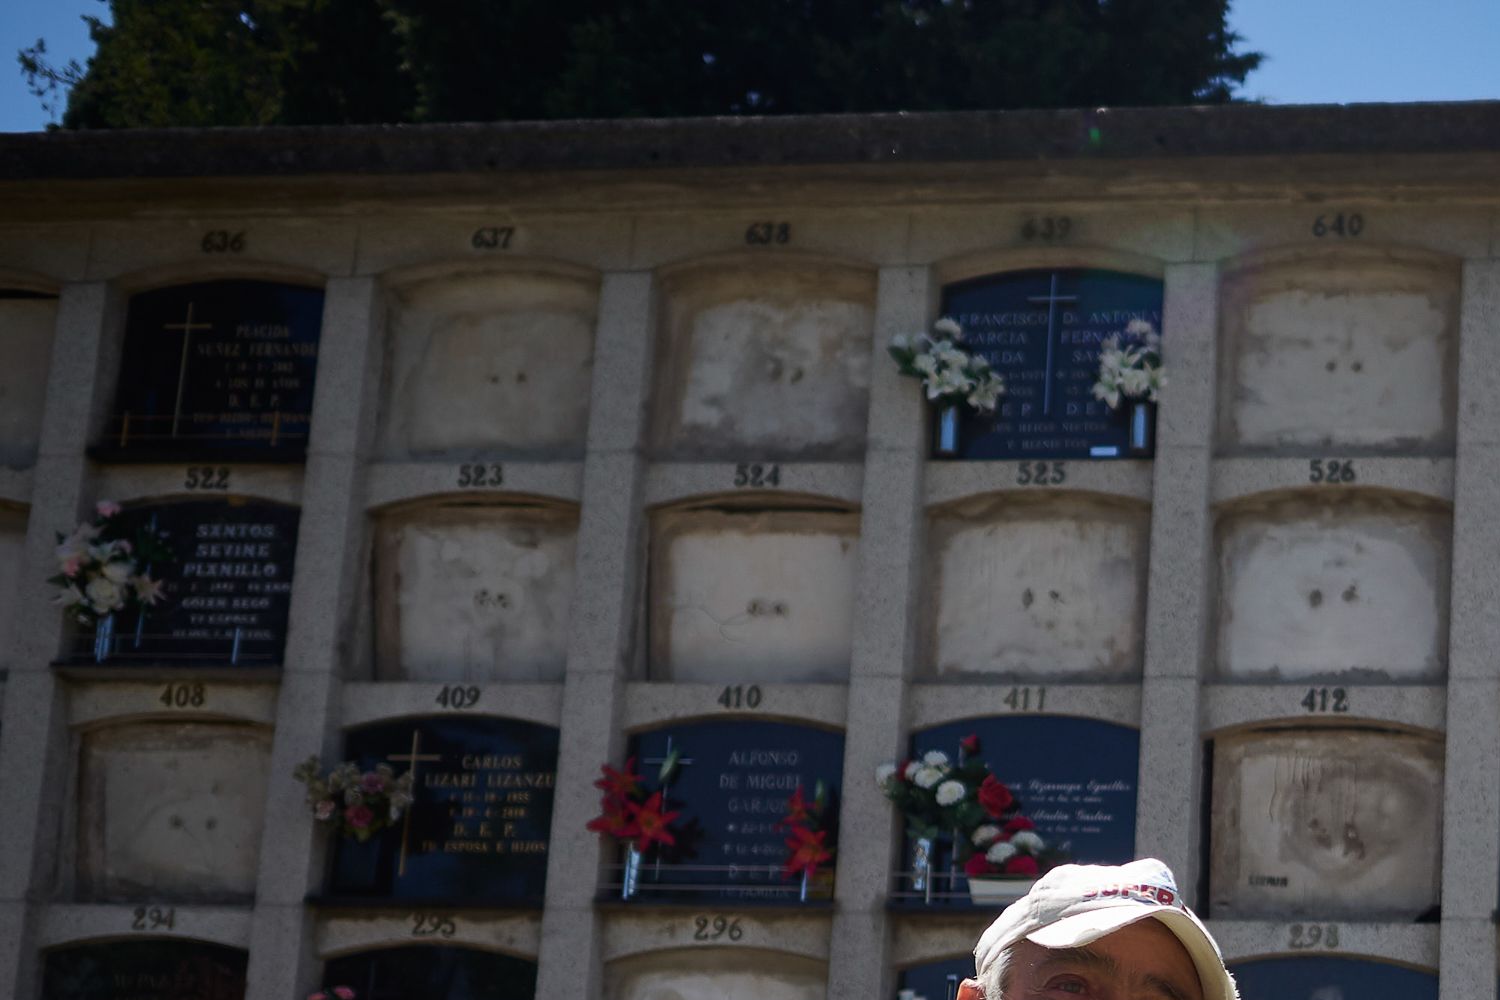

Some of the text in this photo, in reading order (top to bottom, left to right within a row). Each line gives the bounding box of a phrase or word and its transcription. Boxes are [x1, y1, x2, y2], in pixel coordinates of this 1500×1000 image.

[745, 221, 792, 245] 638
[1021, 216, 1073, 240] 639
[1312, 213, 1365, 237] 640
[201, 230, 247, 254] 636
[471, 226, 515, 249] 637
[184, 467, 231, 490] 522
[458, 464, 502, 487] 523
[734, 463, 781, 487] 524
[1017, 461, 1066, 484] 525
[1310, 460, 1355, 483] 526
[160, 685, 205, 708] 408
[435, 685, 482, 709] 409
[717, 685, 763, 709] 410
[1003, 687, 1047, 711] 411
[1301, 687, 1348, 712] 412
[132, 907, 175, 930] 294
[411, 912, 456, 937] 295
[694, 915, 743, 941] 296
[1288, 924, 1339, 948] 298
